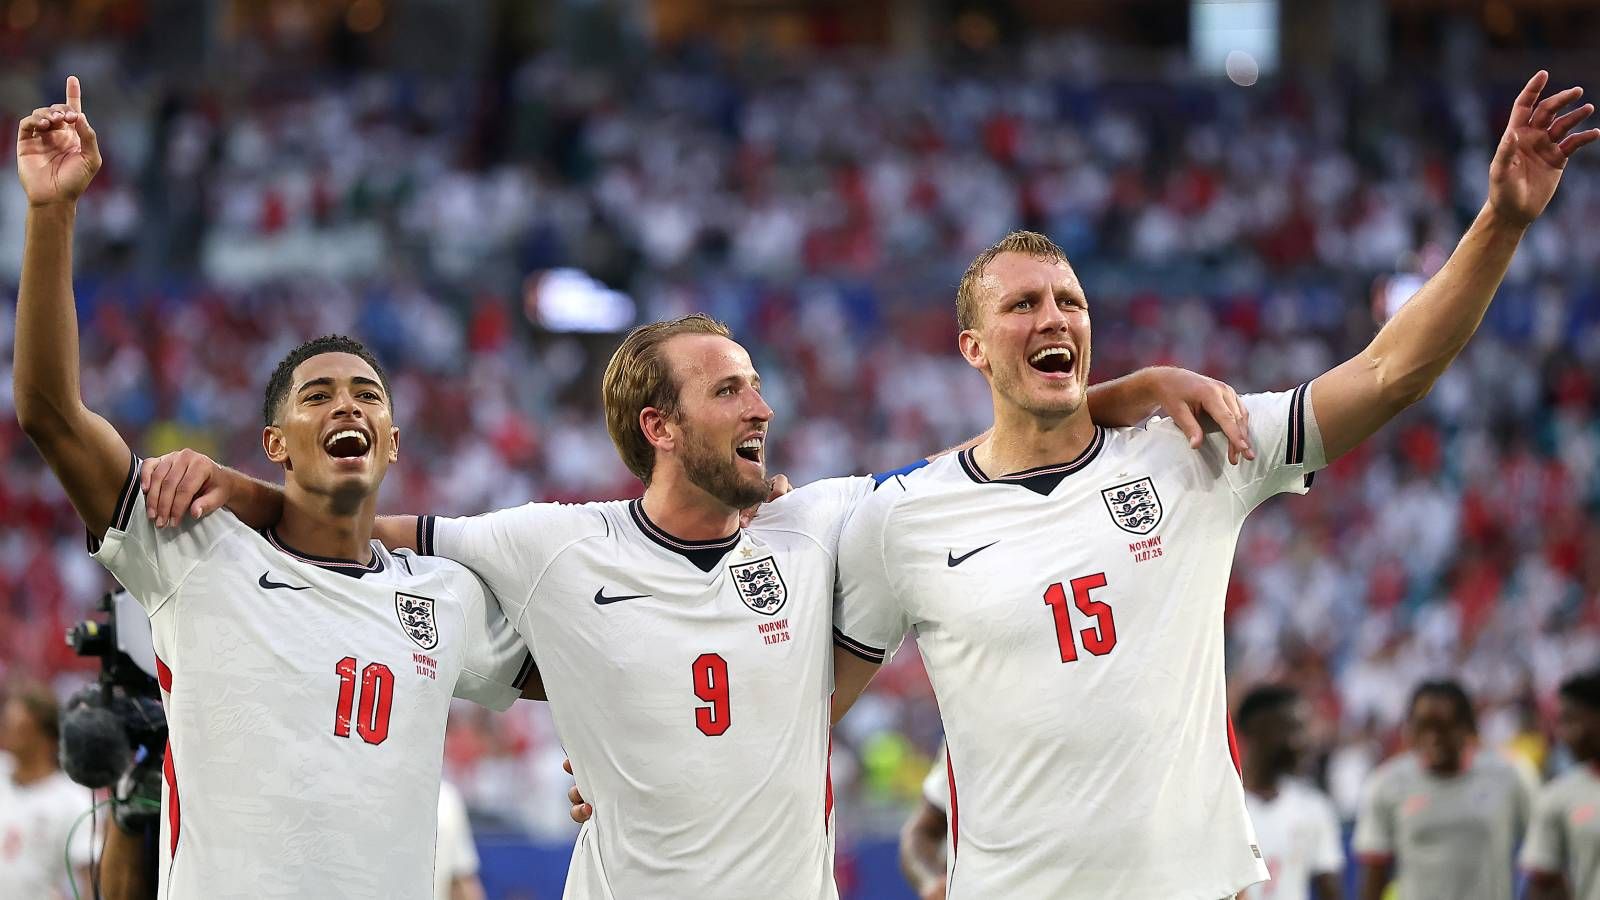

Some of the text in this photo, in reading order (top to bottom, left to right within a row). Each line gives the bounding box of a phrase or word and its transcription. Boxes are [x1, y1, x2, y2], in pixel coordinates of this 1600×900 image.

[1129, 536, 1161, 552] NORWAY
[1135, 548, 1163, 563] 11.07.26
[1043, 572, 1117, 663] 15
[764, 632, 790, 645] 11.07.26
[412, 653, 437, 669] NORWAY
[334, 656, 395, 745] 10
[692, 653, 731, 736] 9
